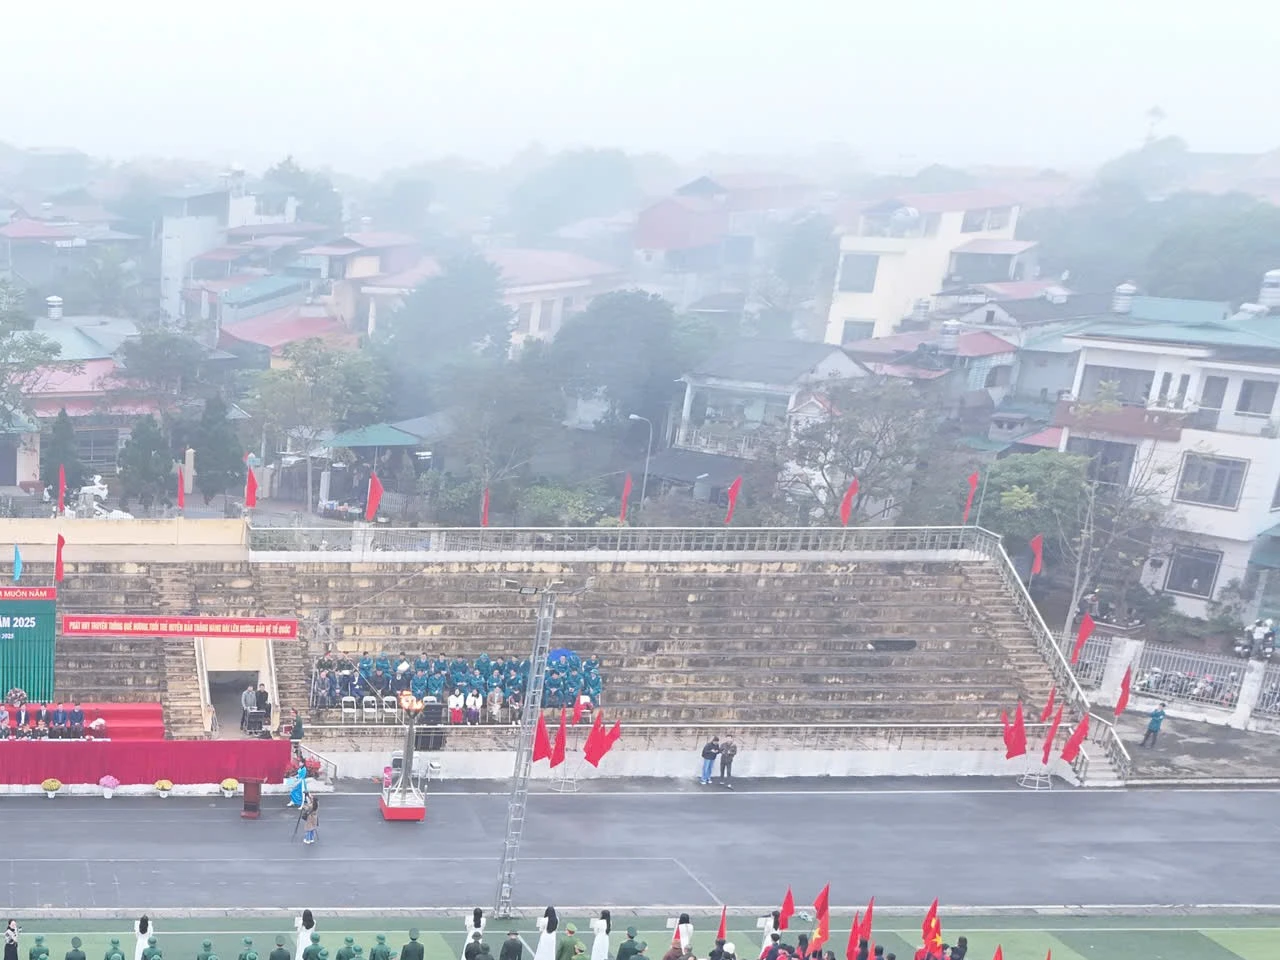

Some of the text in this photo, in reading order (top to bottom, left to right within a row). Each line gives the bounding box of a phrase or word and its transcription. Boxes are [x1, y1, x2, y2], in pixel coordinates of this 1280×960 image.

[4, 589, 27, 597] MUÔN
[29, 589, 47, 597] NĂM
[12, 616, 36, 628] 2025
